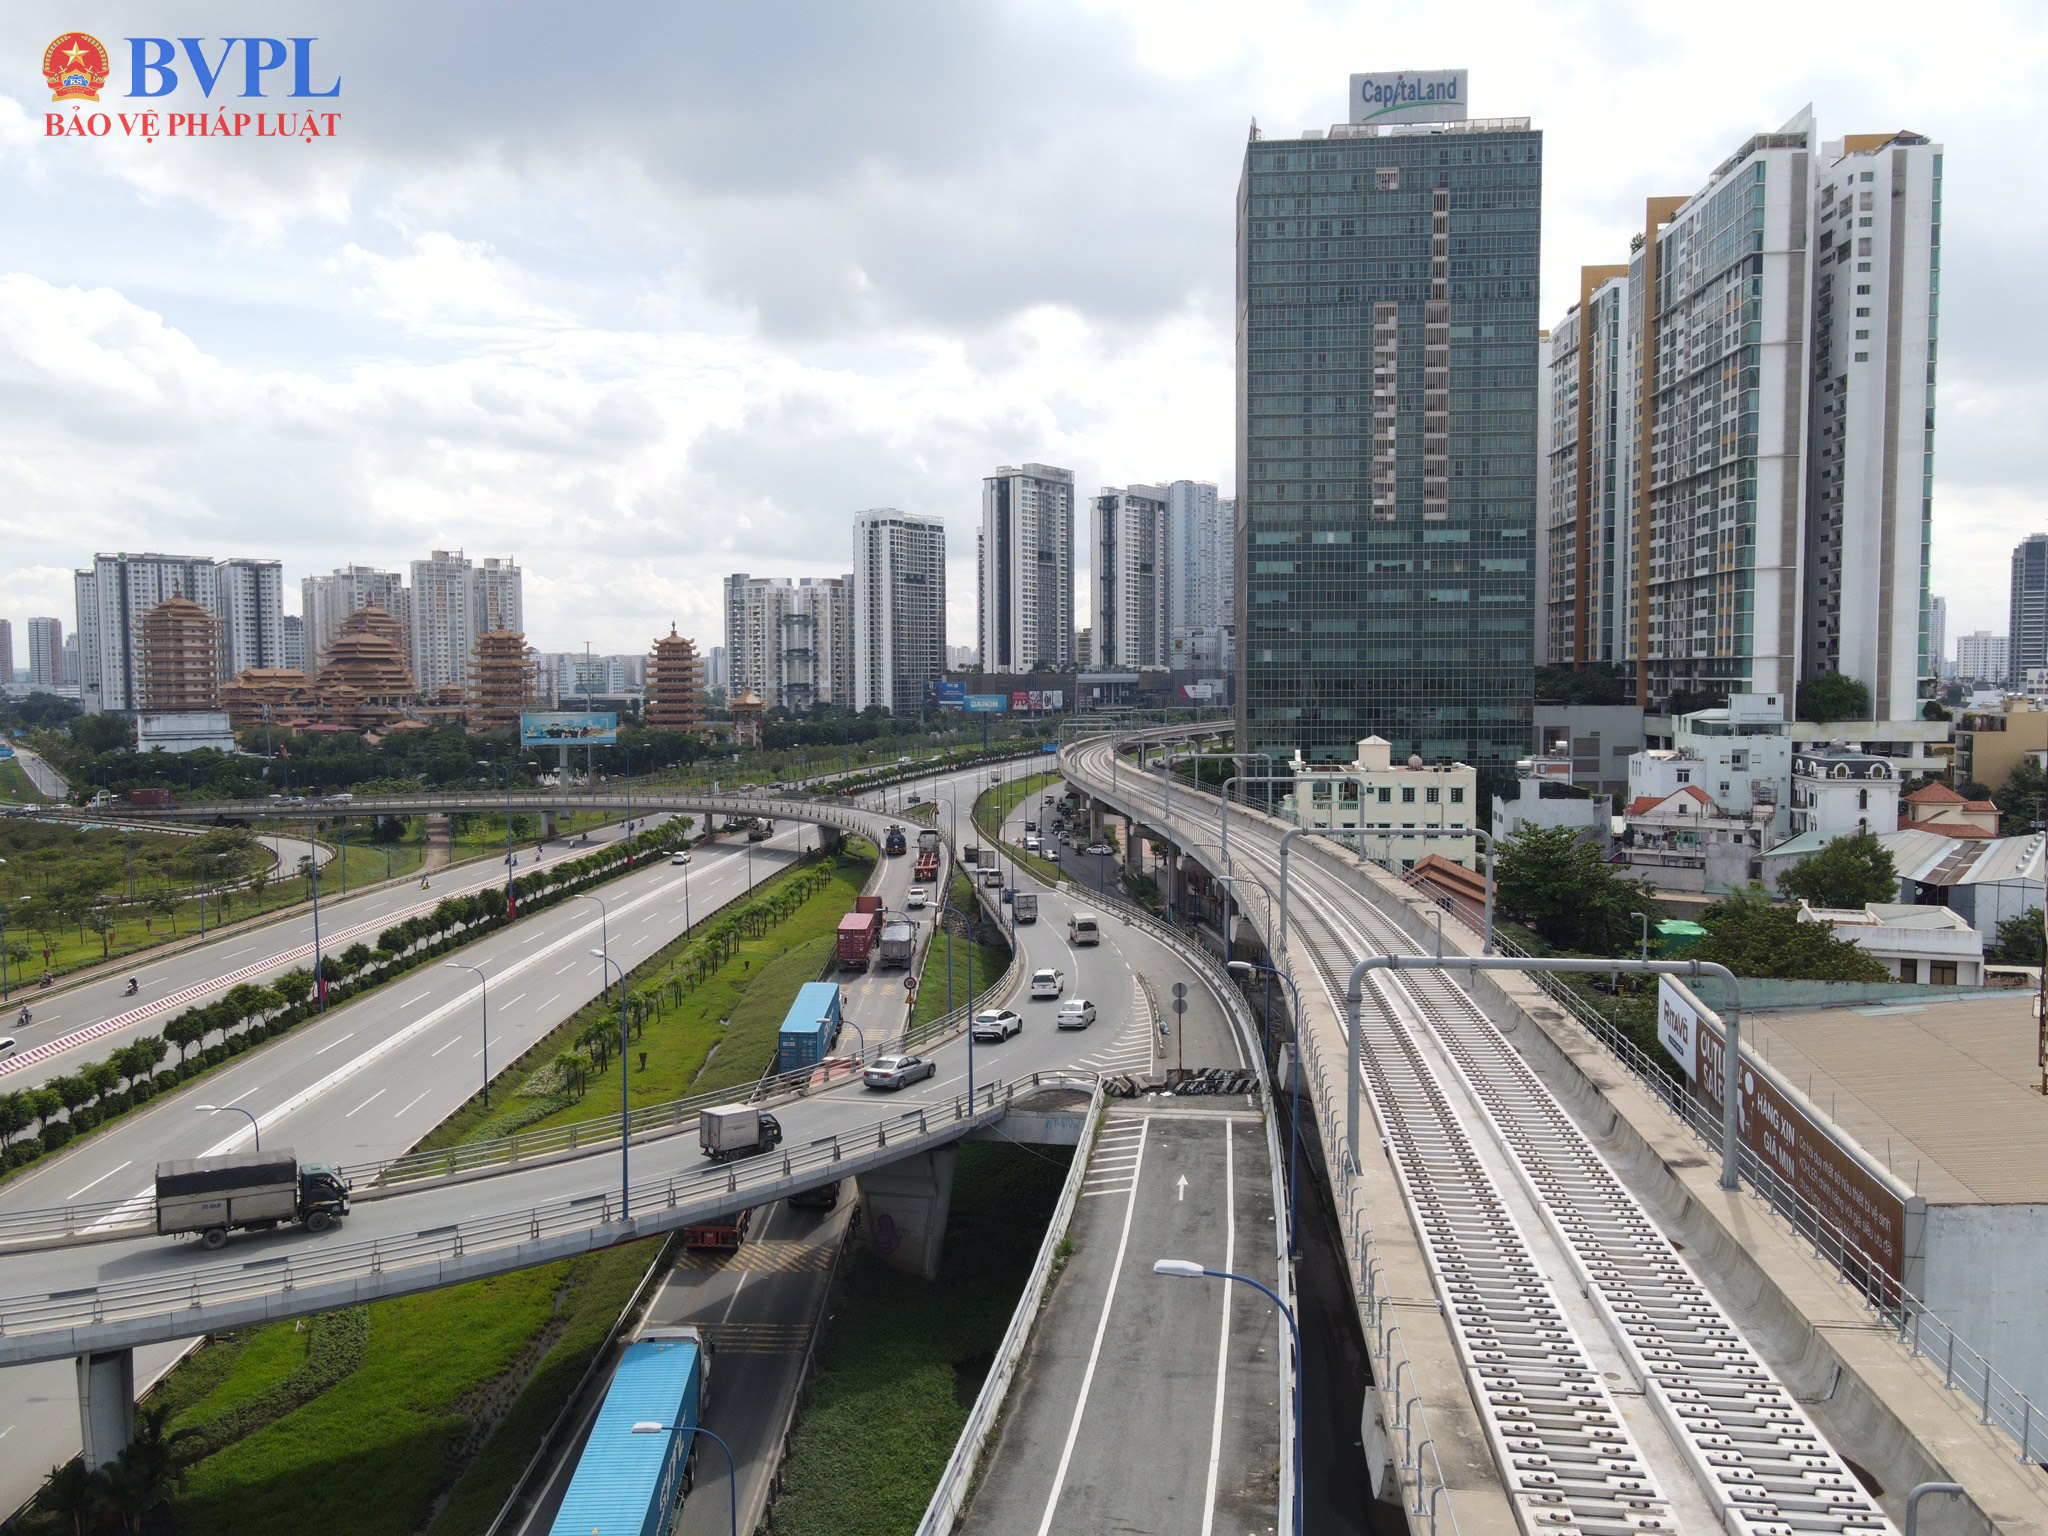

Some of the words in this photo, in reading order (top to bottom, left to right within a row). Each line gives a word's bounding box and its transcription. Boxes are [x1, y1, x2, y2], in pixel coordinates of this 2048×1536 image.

[1362, 74, 1457, 107] CapitaLand
[1757, 1092, 1779, 1131] HÀNG
[1780, 1115, 1795, 1147] XỊN
[1763, 1131, 1778, 1161] GIÁ
[1779, 1146, 1795, 1180] MỊN
